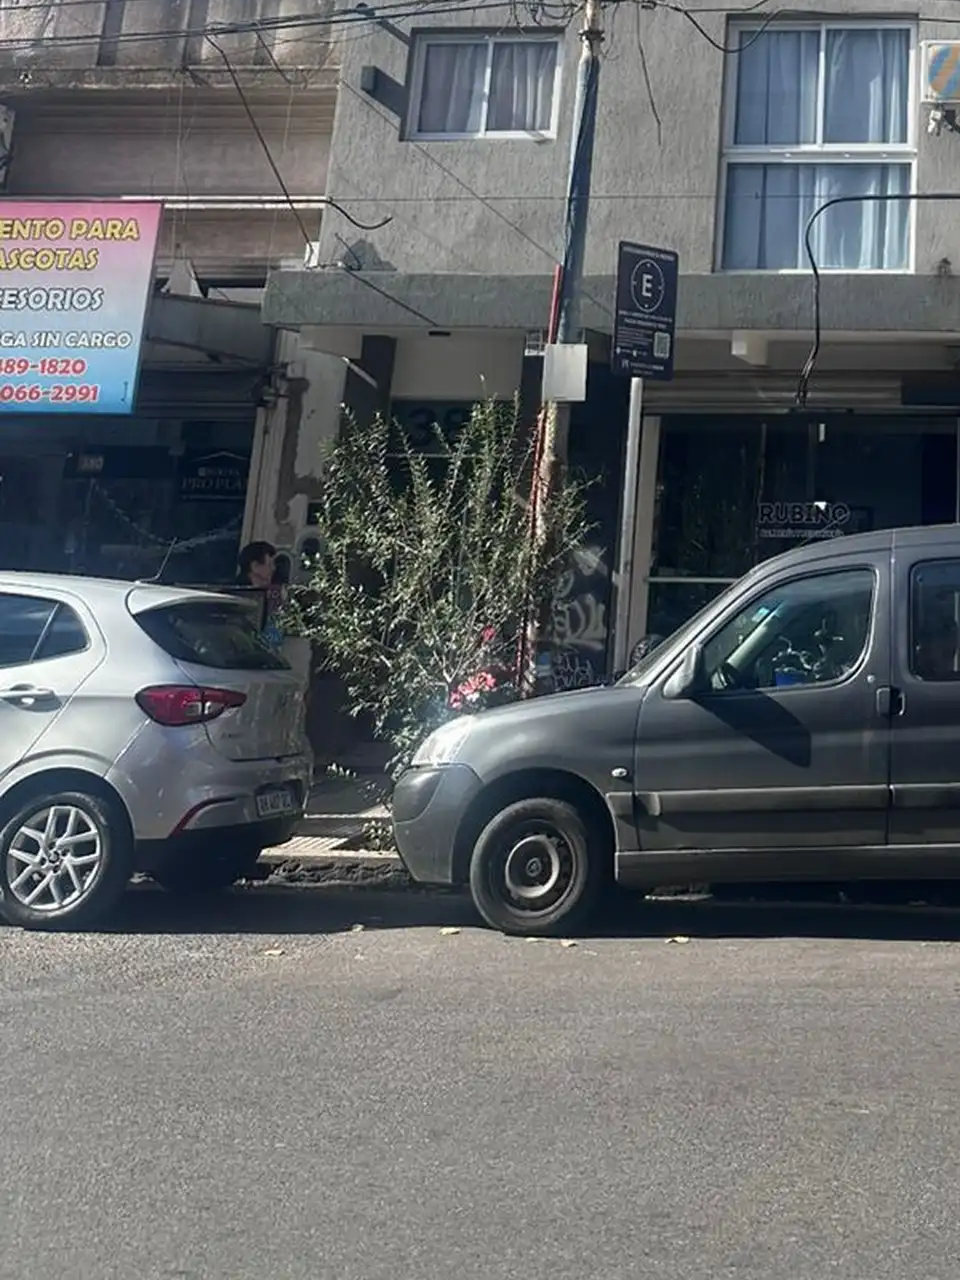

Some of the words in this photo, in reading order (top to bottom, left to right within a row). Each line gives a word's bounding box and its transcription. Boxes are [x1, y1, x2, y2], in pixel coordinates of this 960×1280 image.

[70, 218, 140, 241] PARA
[641, 273, 653, 297] E
[0, 287, 104, 311] ESORIOS
[31, 332, 61, 348] SIN
[64, 332, 133, 348] CARGO
[758, 501, 851, 524] RUBINO
